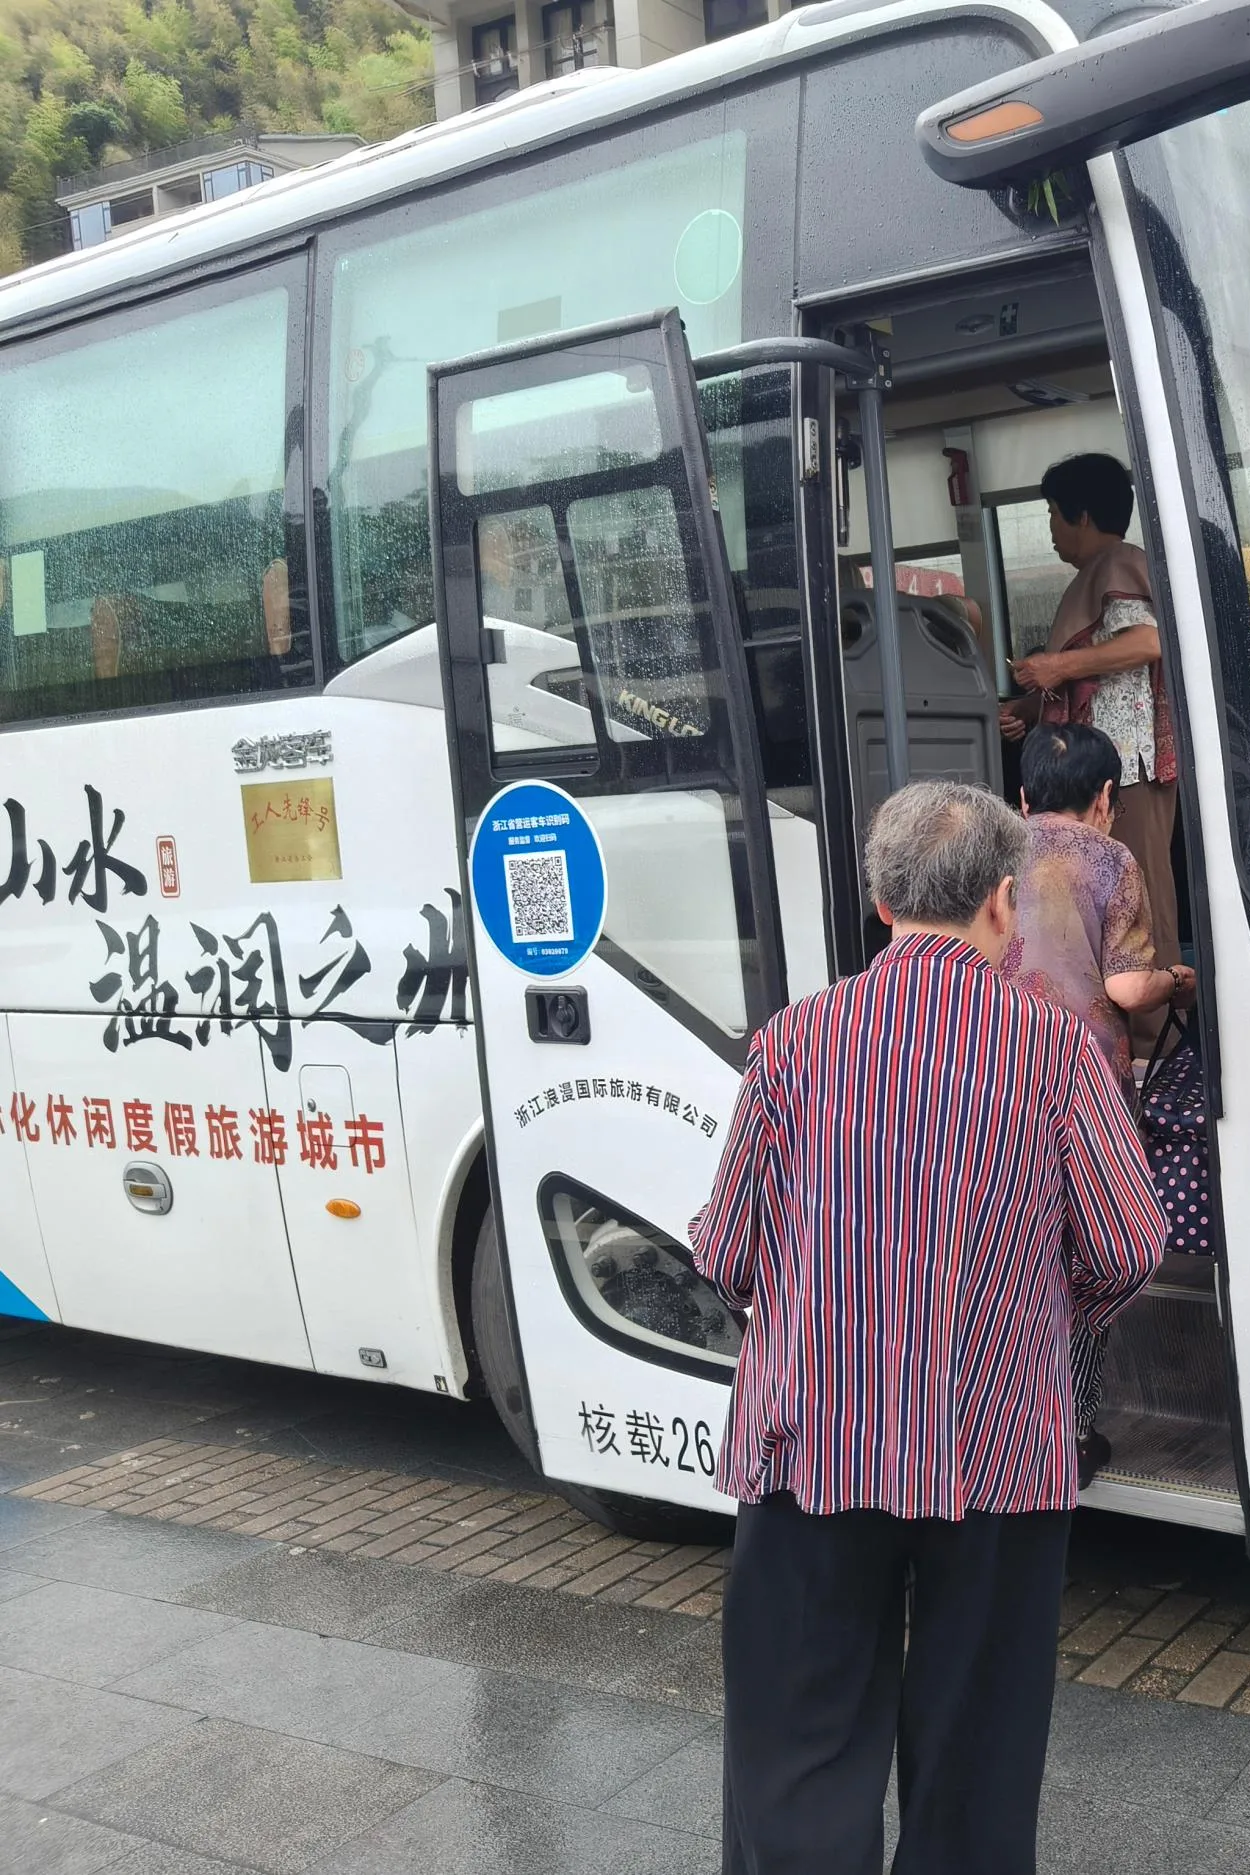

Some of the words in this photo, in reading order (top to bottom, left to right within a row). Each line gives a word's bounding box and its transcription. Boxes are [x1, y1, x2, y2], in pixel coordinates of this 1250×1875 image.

[619, 688, 704, 737] KINGLO
[251, 793, 330, 835] 工人先锋号
[160, 844, 178, 888] 旅游
[514, 1078, 718, 1138] 浙江浪漫国际旅游有限公司
[0, 1092, 386, 1174] 化休闲度假旅游城市
